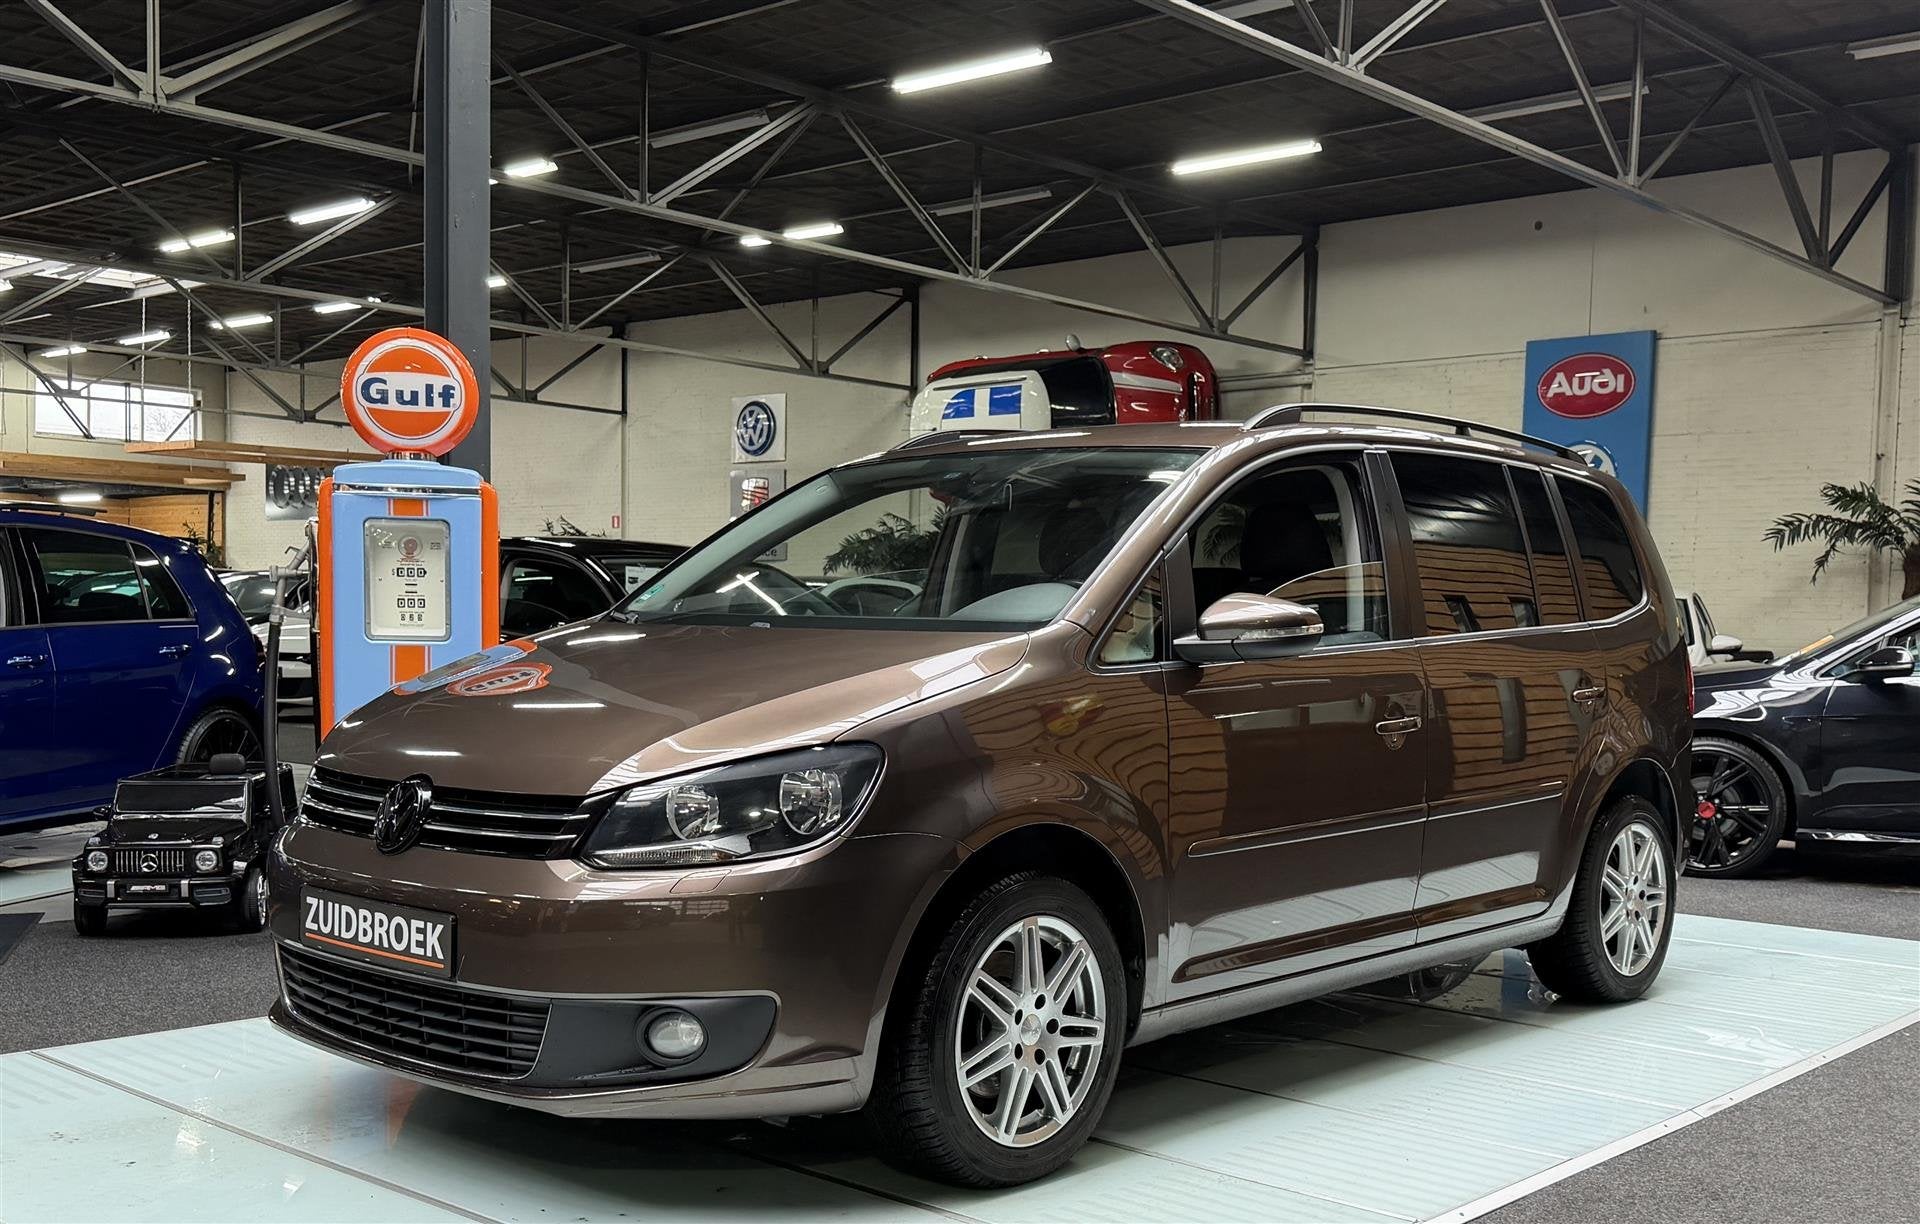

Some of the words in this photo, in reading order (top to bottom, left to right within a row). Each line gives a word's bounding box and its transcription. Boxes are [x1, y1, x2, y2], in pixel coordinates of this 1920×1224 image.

[360, 376, 456, 408] Gulf
[1546, 367, 1625, 398] Audi
[304, 896, 444, 960] ZUIDBROEK
